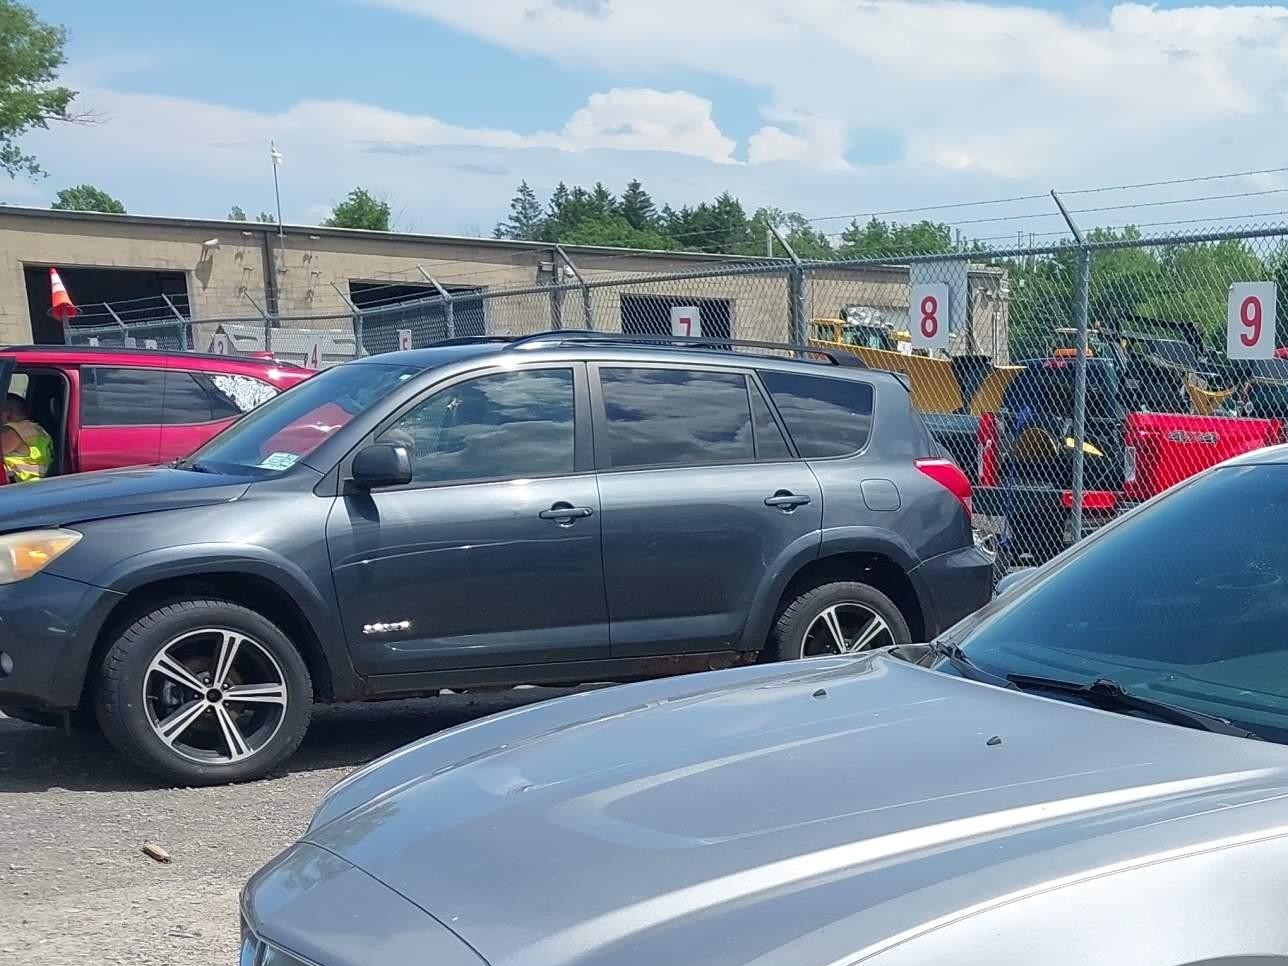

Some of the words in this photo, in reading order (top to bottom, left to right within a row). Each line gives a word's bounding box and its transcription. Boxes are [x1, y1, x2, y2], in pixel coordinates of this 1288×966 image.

[679, 317, 691, 337] 7
[920, 295, 938, 338] 8
[1240, 295, 1262, 347] 9
